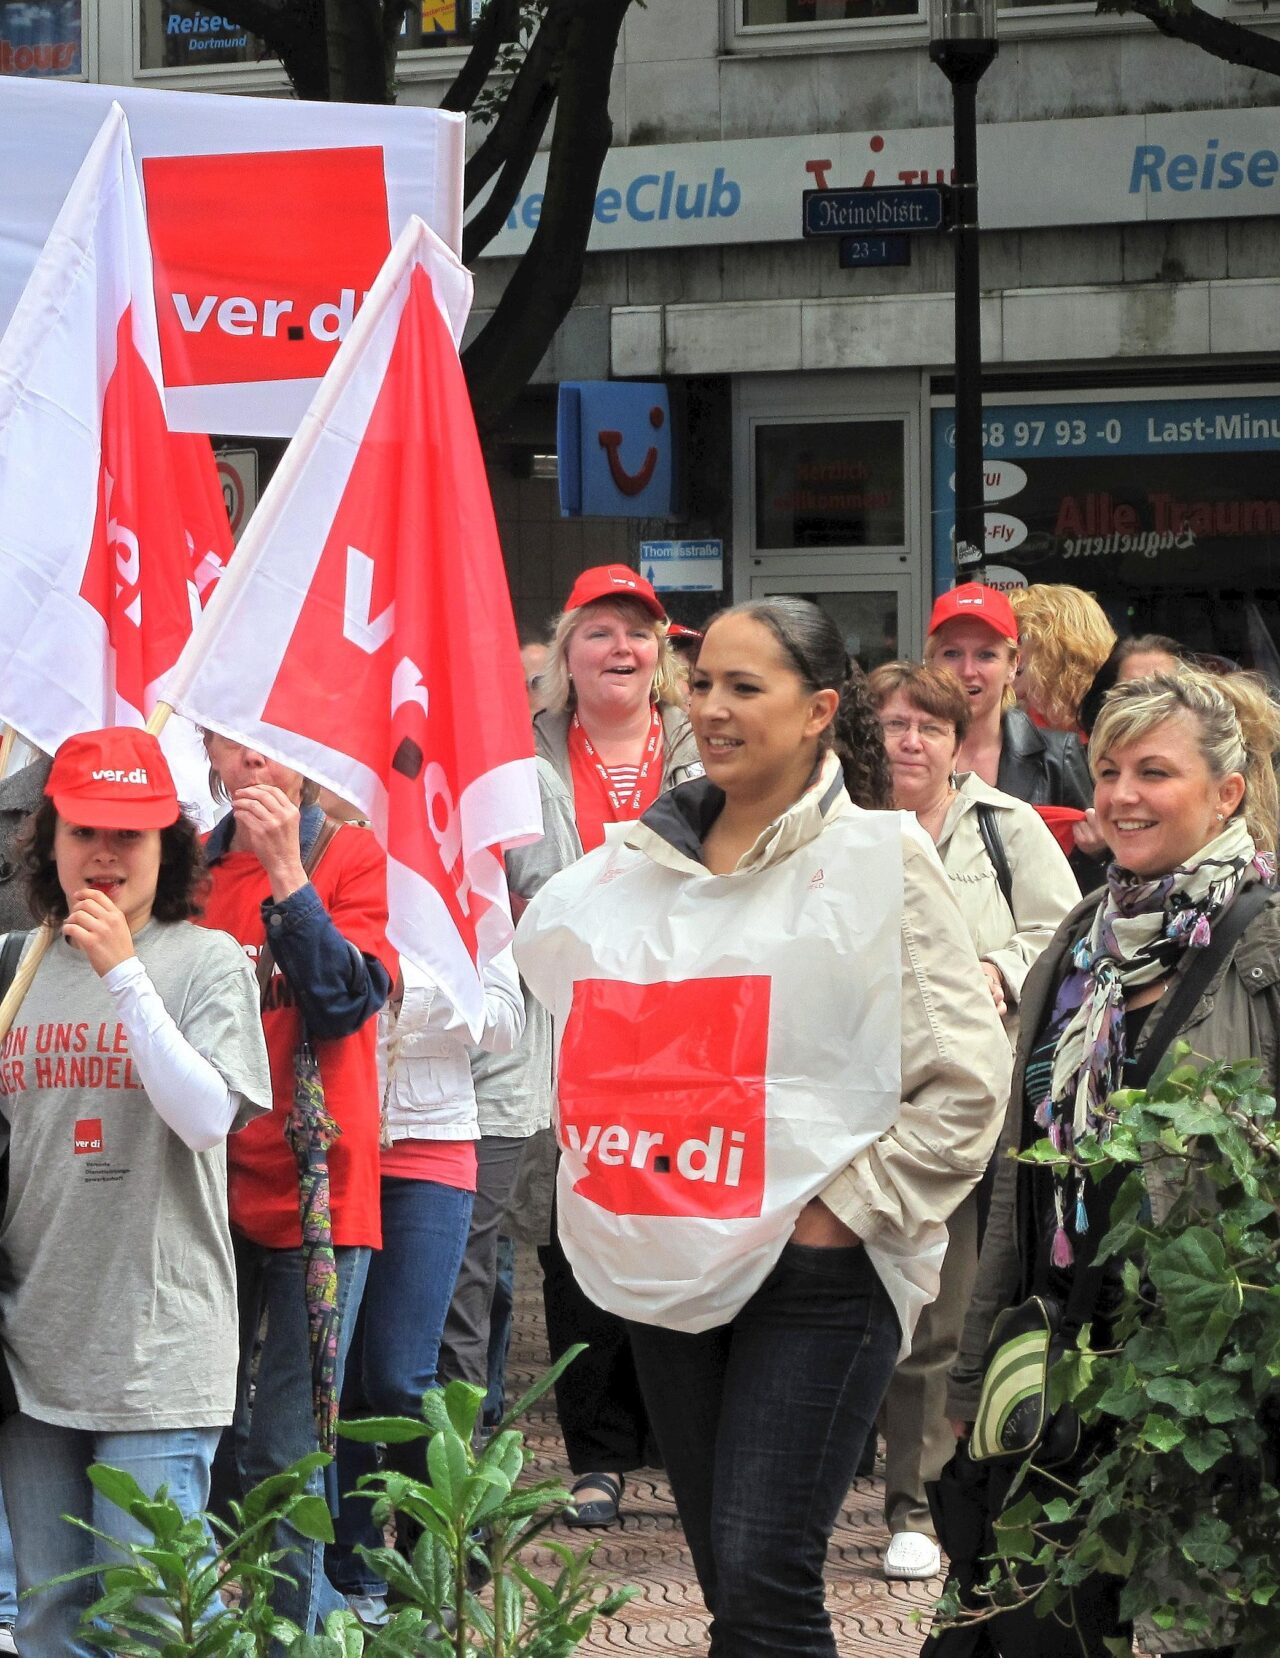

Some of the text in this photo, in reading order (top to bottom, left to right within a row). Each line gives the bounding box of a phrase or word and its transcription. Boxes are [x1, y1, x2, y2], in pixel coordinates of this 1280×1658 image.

[188, 34, 247, 50] Dortmund
[1128, 138, 1279, 193] Reise
[820, 198, 928, 227] Reinoldistr.
[172, 288, 371, 342] ver.d
[1014, 421, 1046, 446] 97
[1056, 420, 1087, 445] 93
[984, 578, 1024, 592] inson
[92, 767, 148, 785] ver.di
[1, 1026, 28, 1060] ON
[35, 1023, 89, 1053] UNS
[565, 1124, 746, 1187] ver.di
